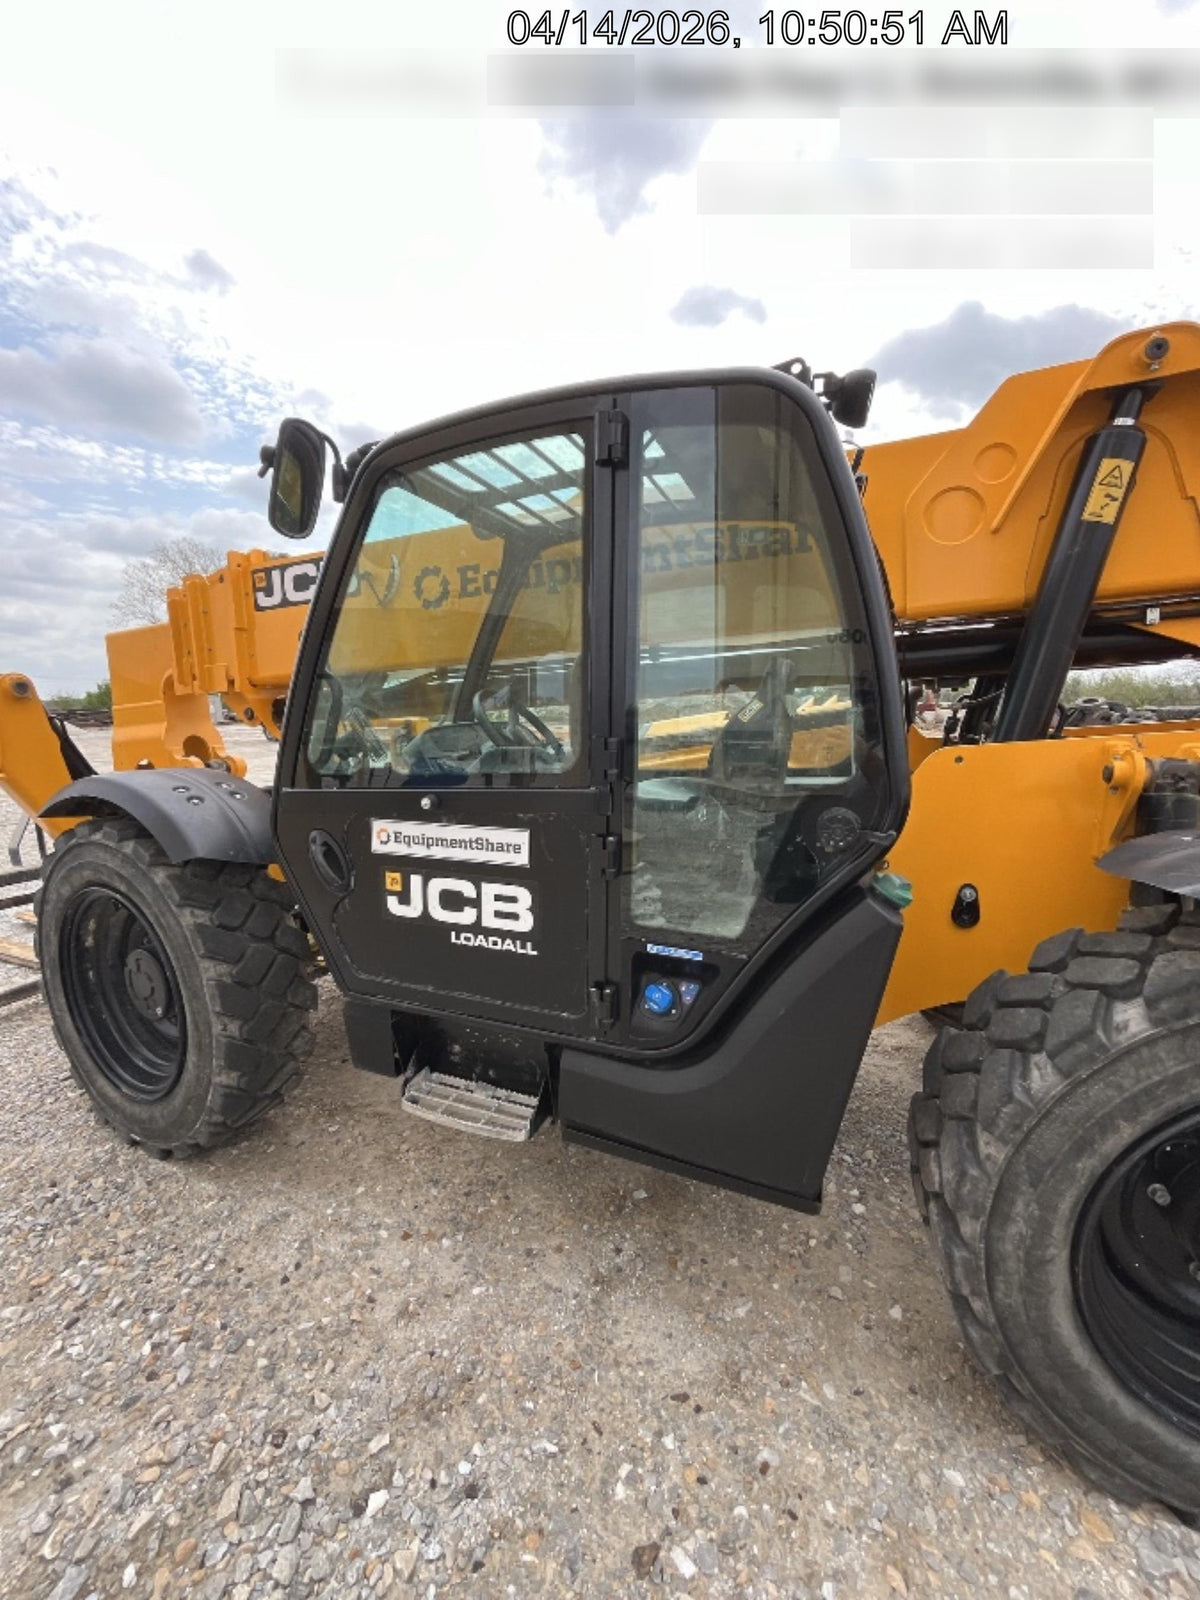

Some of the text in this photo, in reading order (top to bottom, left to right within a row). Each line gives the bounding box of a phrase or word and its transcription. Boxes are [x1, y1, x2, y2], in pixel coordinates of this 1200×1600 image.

[255, 561, 325, 607] JC
[394, 831, 522, 854] EquipmentShare
[387, 873, 535, 933] JCB
[450, 930, 538, 956] LOADALL
